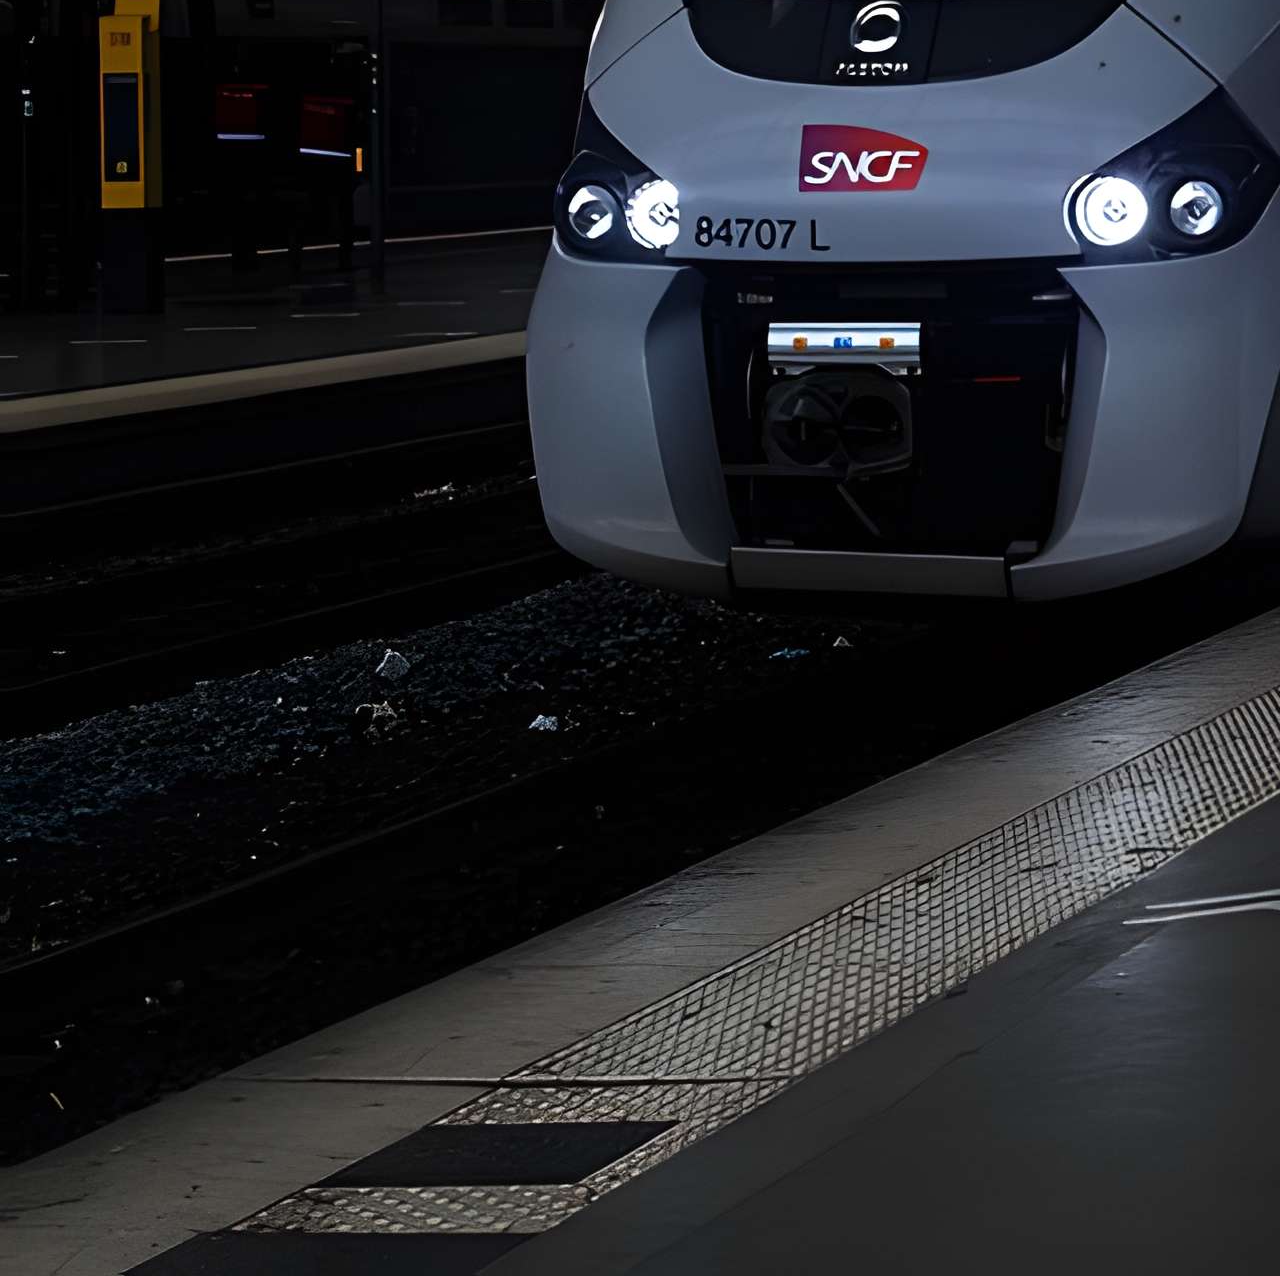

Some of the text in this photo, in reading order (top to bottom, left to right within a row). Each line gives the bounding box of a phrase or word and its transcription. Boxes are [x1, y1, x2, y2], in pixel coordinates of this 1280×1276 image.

[803, 150, 921, 185] SNCF
[694, 215, 831, 252] 84707 L
